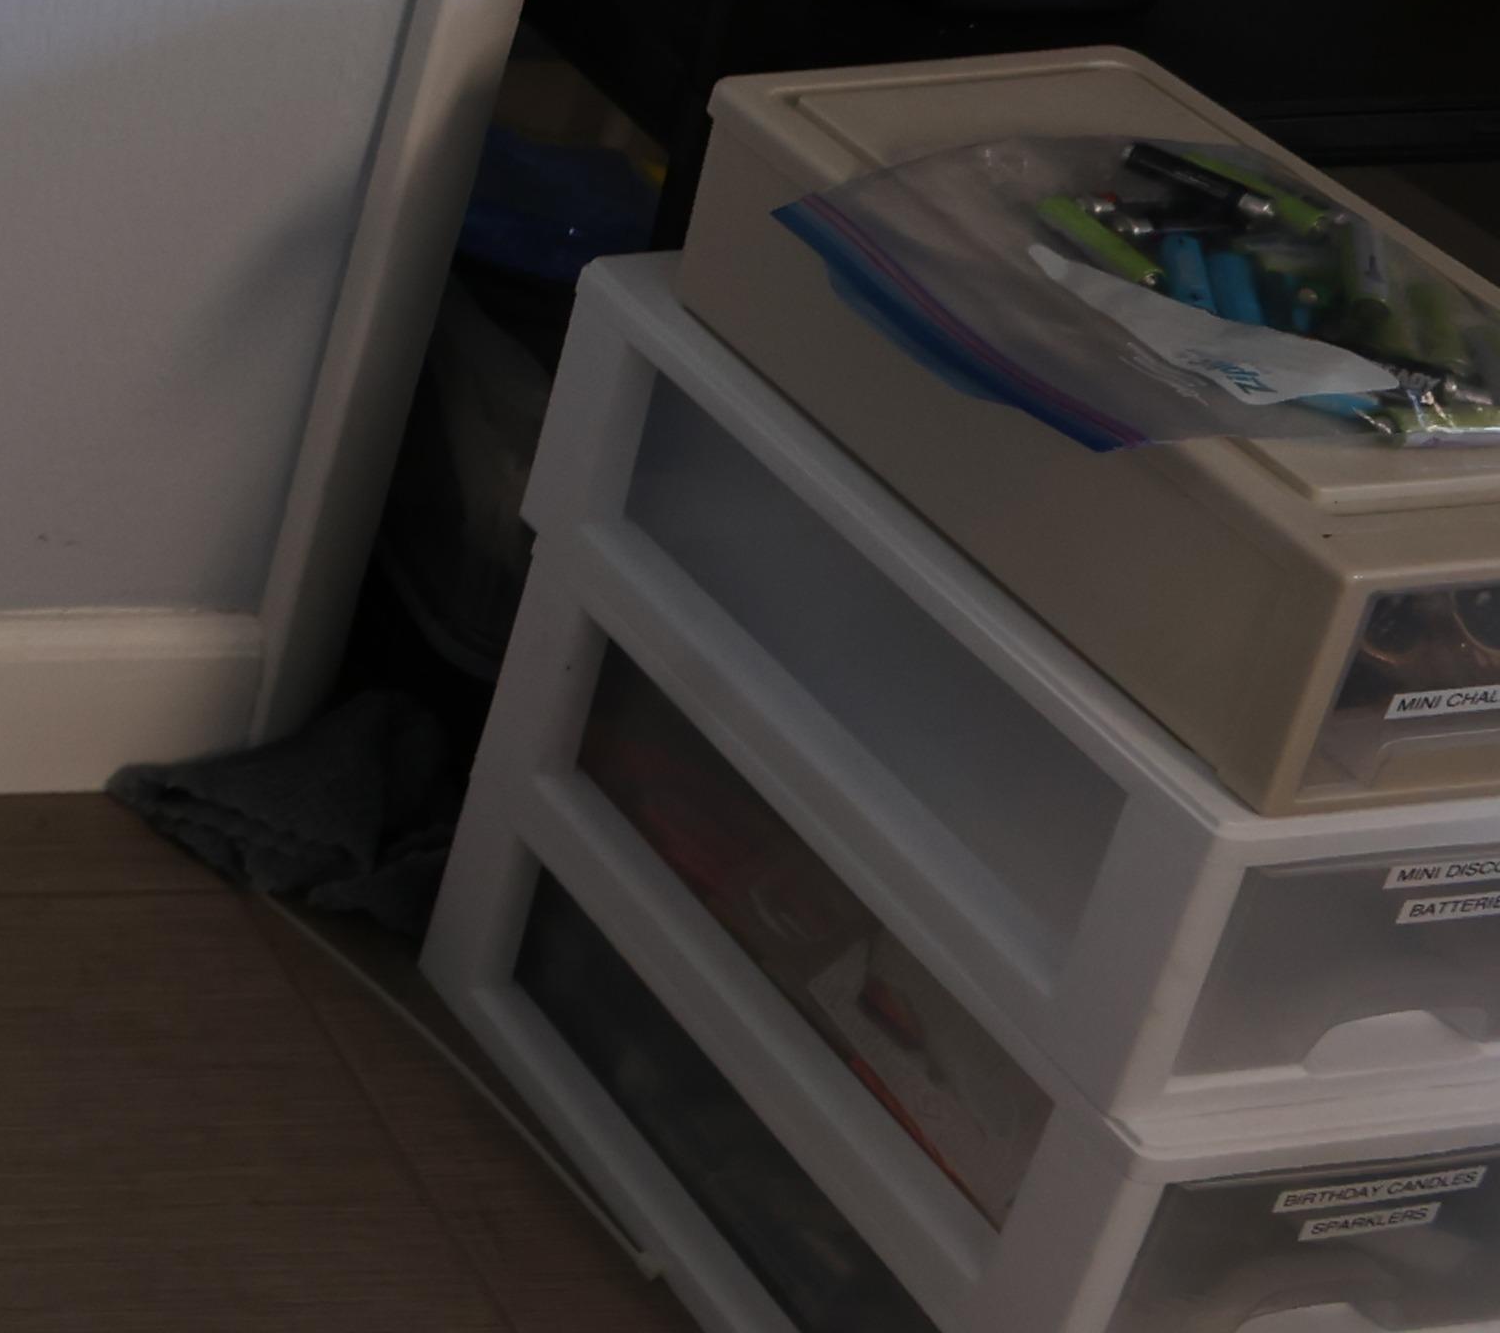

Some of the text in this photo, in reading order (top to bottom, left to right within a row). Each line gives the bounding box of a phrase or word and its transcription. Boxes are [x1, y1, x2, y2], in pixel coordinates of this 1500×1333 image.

[1396, 690, 1498, 712] MINI CHAL
[1396, 866, 1442, 882] MINI
[1282, 1171, 1479, 1208] BIRTHDAY CANDLES
[1310, 1207, 1430, 1236] SPARKLERS
